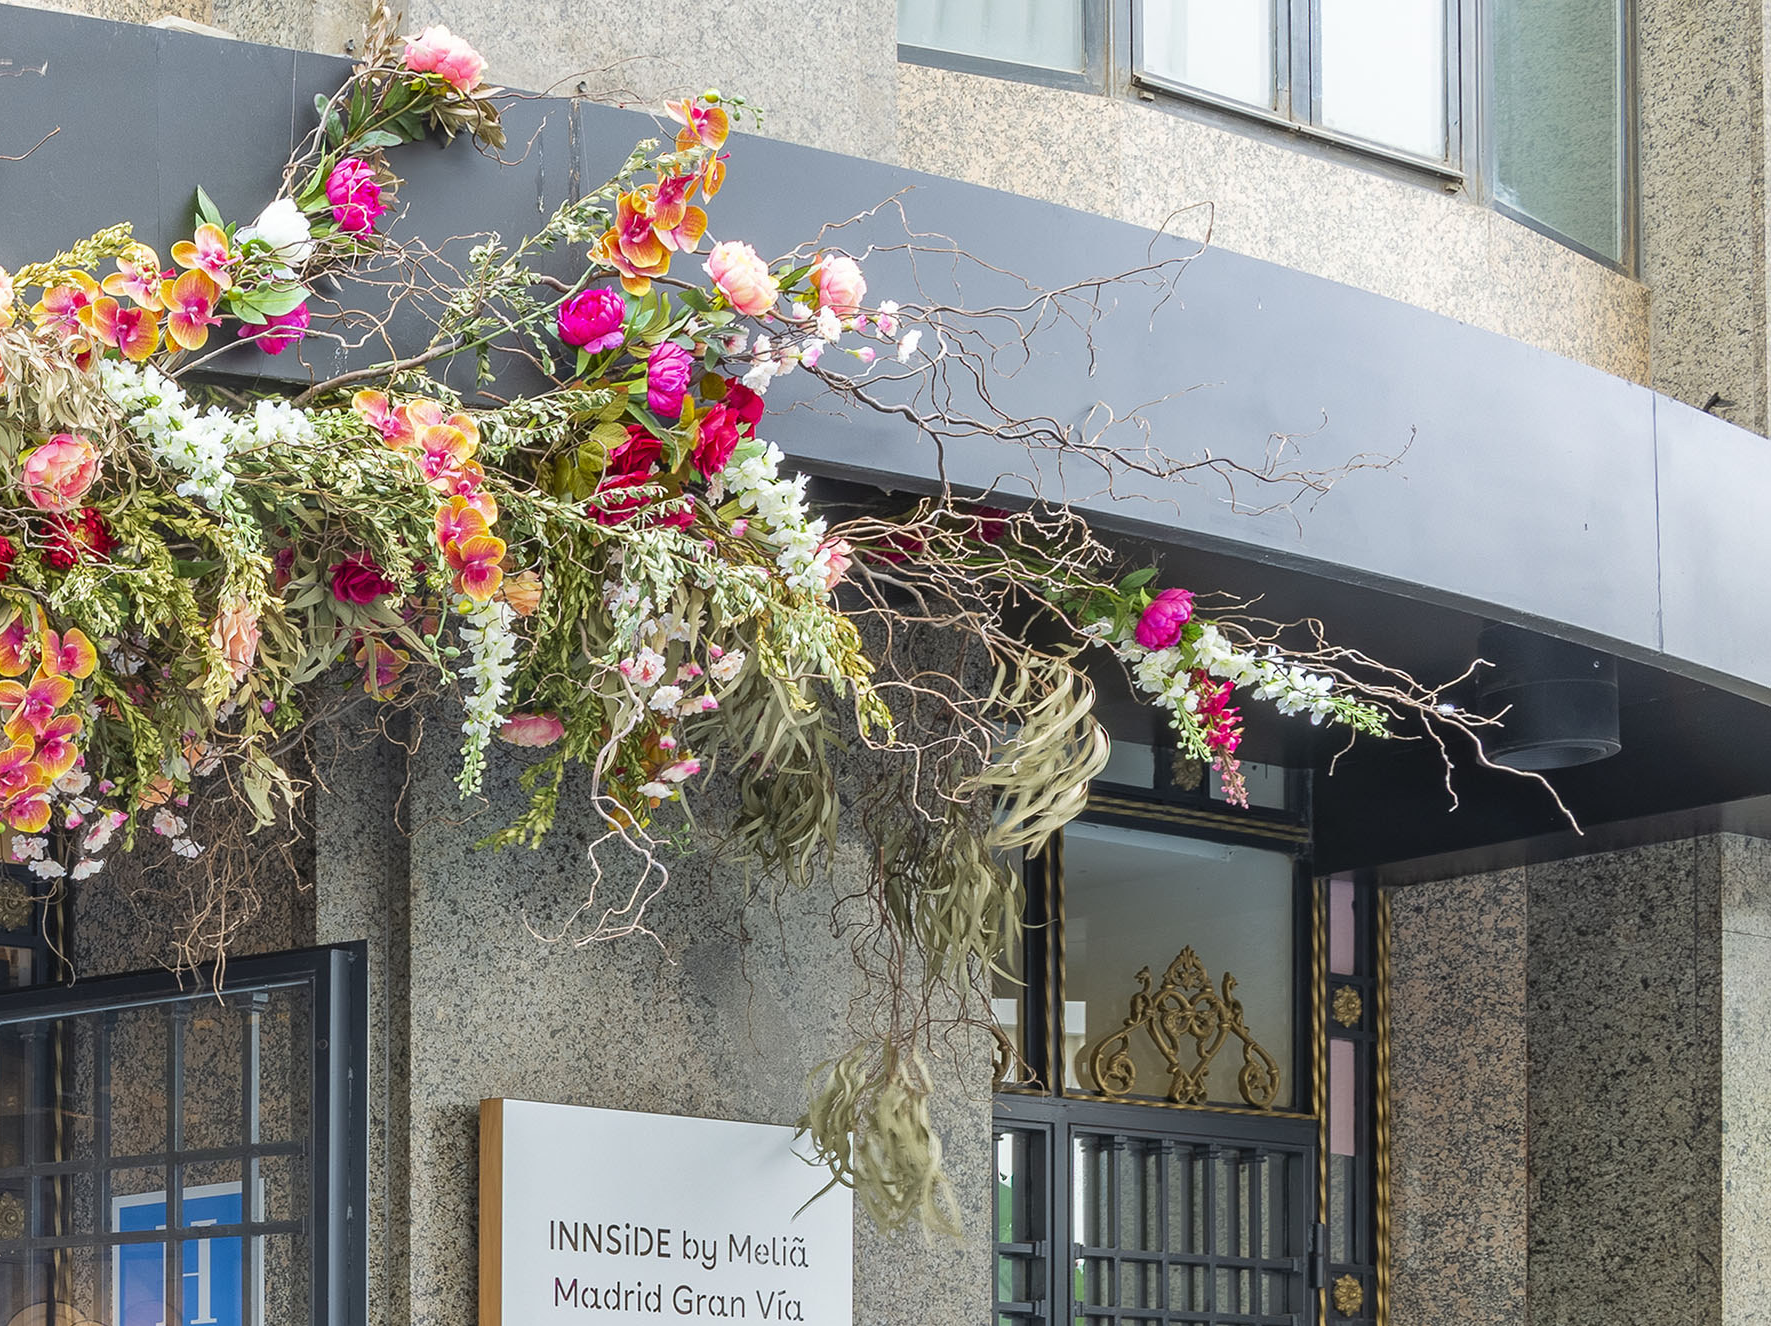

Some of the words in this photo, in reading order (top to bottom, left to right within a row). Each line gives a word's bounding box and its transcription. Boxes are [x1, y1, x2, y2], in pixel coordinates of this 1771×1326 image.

[550, 1219, 671, 1259] INNSiDE
[683, 1230, 717, 1270] by
[554, 1276, 662, 1314] Madrid
[673, 1284, 746, 1319] Gran
[756, 1289, 805, 1322] Vía
